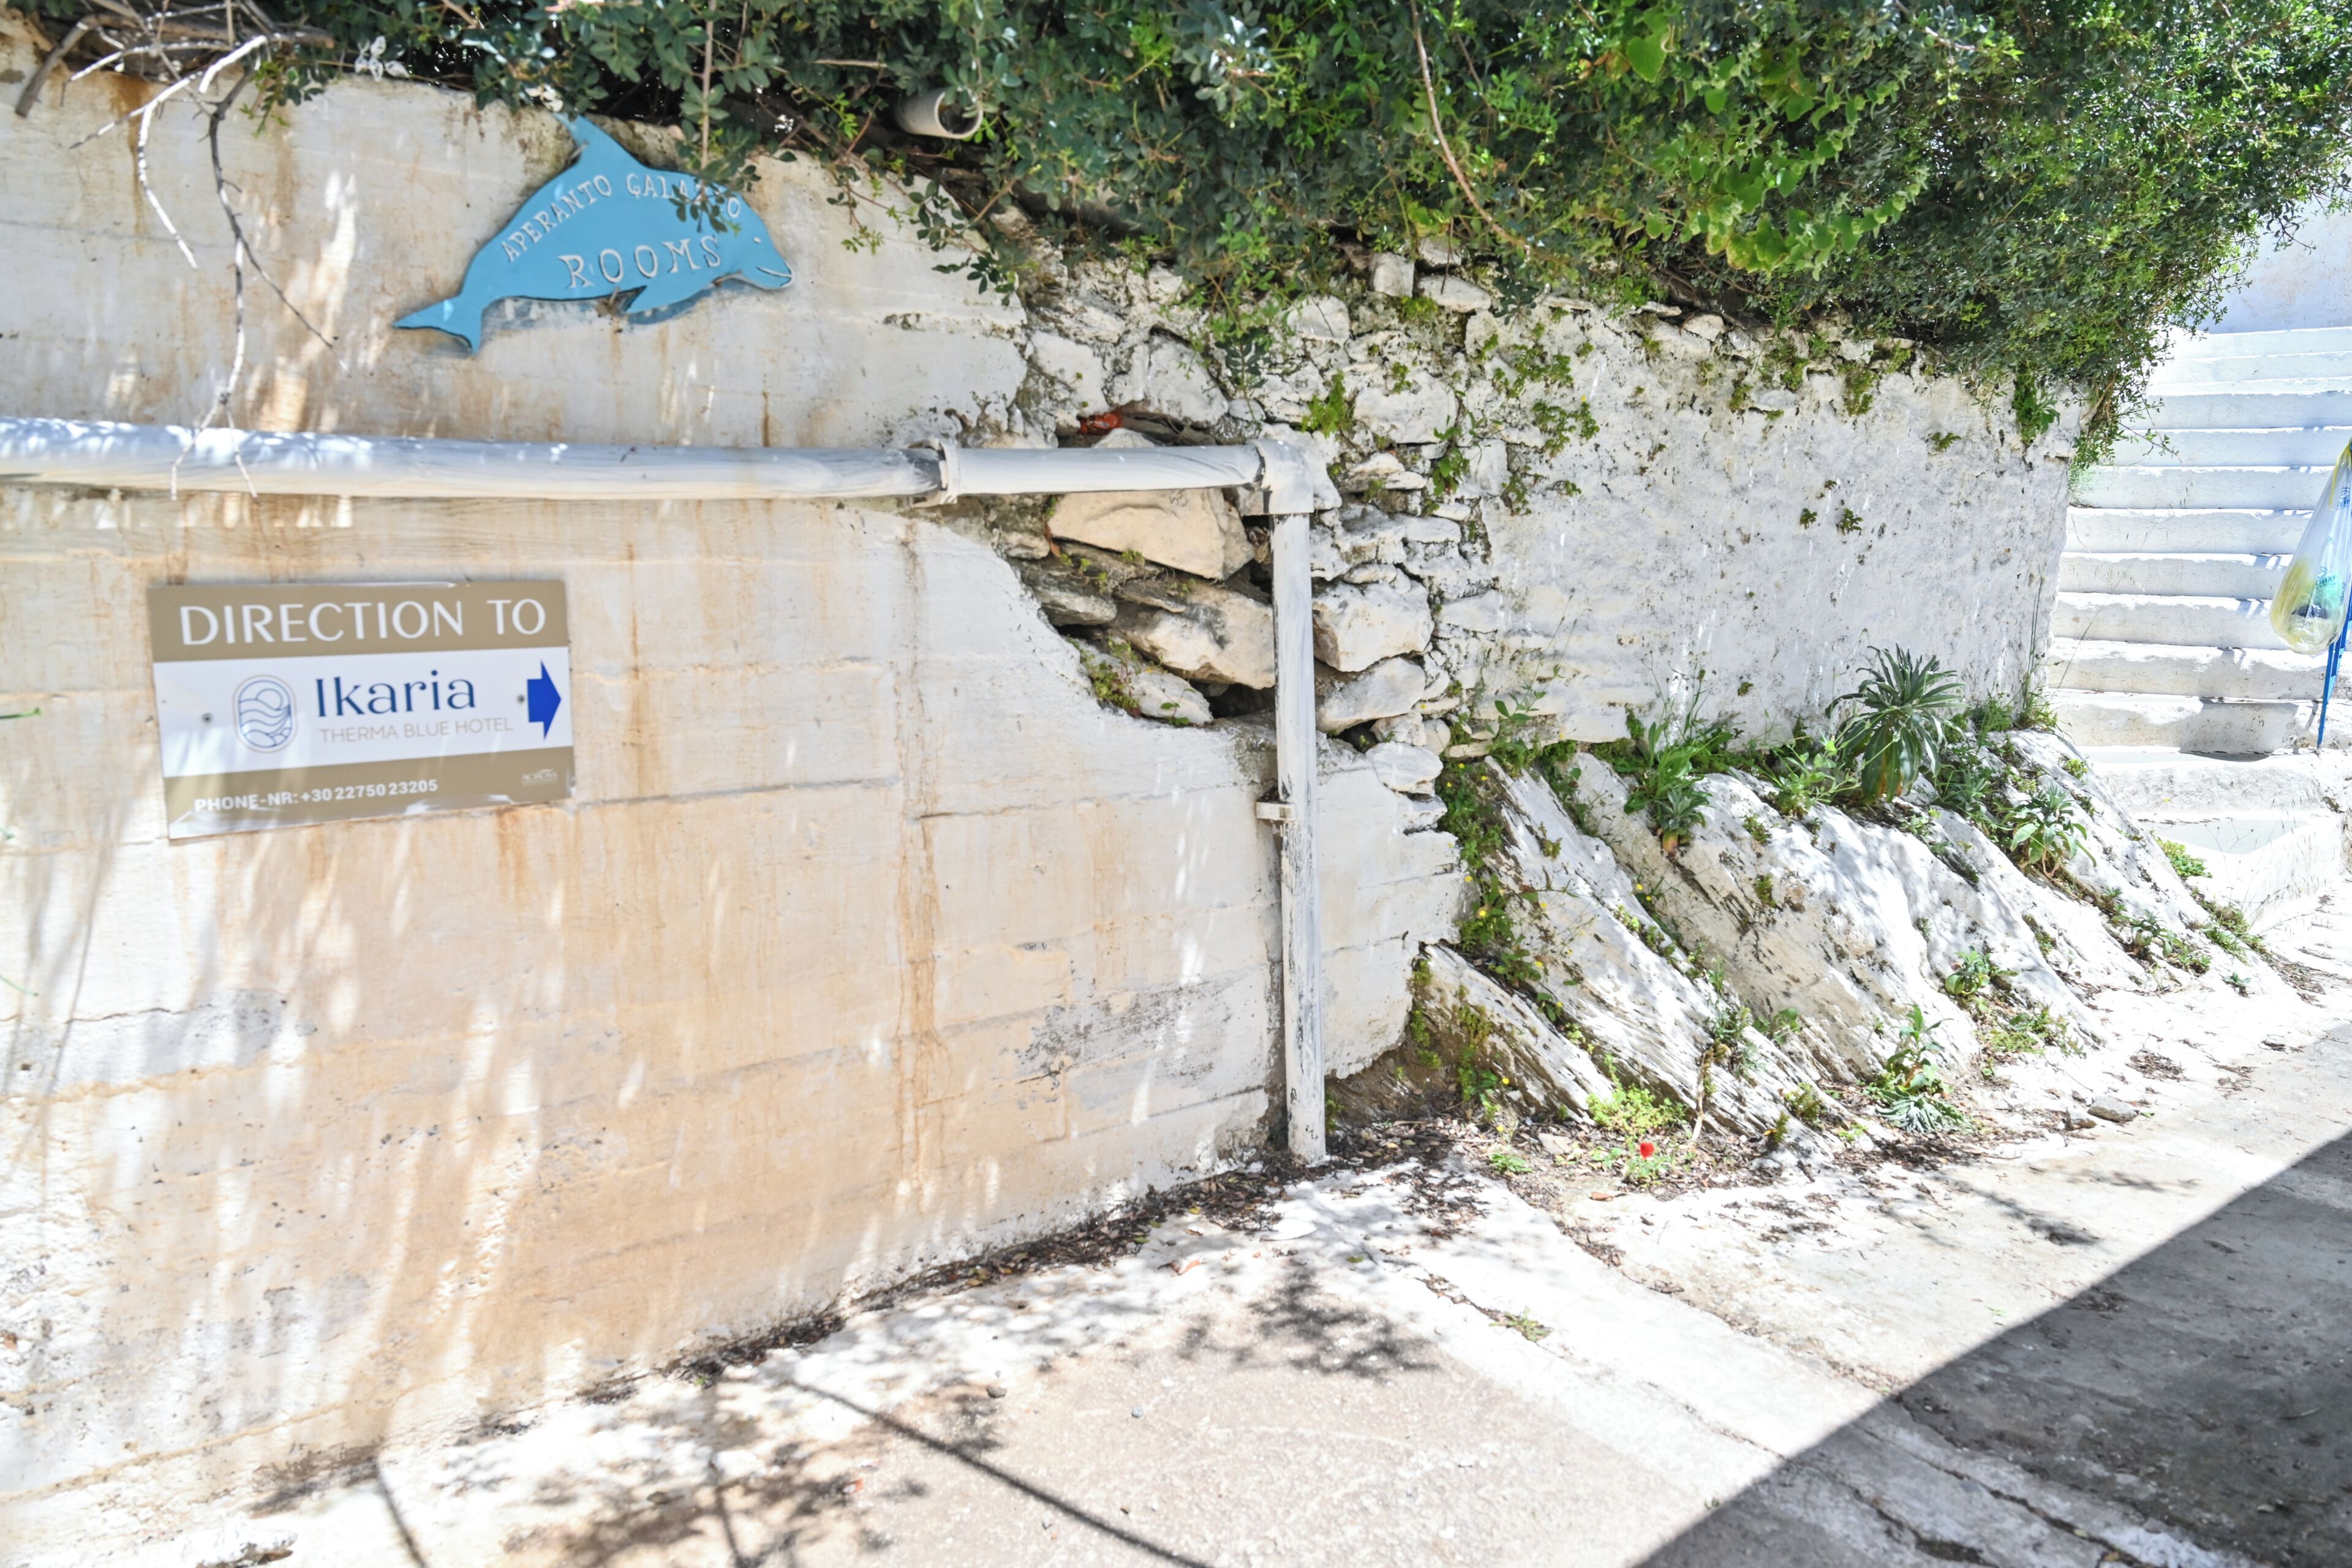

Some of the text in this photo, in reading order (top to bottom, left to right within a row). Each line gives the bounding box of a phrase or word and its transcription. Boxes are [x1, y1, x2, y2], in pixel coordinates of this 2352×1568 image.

[501, 175, 611, 262] APERANTO
[558, 235, 722, 288] ROOMS
[179, 598, 548, 646] DIRECTION TO
[315, 669, 476, 717] Ikaria
[319, 717, 514, 743] THERMA BLUE HOTEL
[194, 779, 439, 812] PHONE-NR: +30 22750 23205
